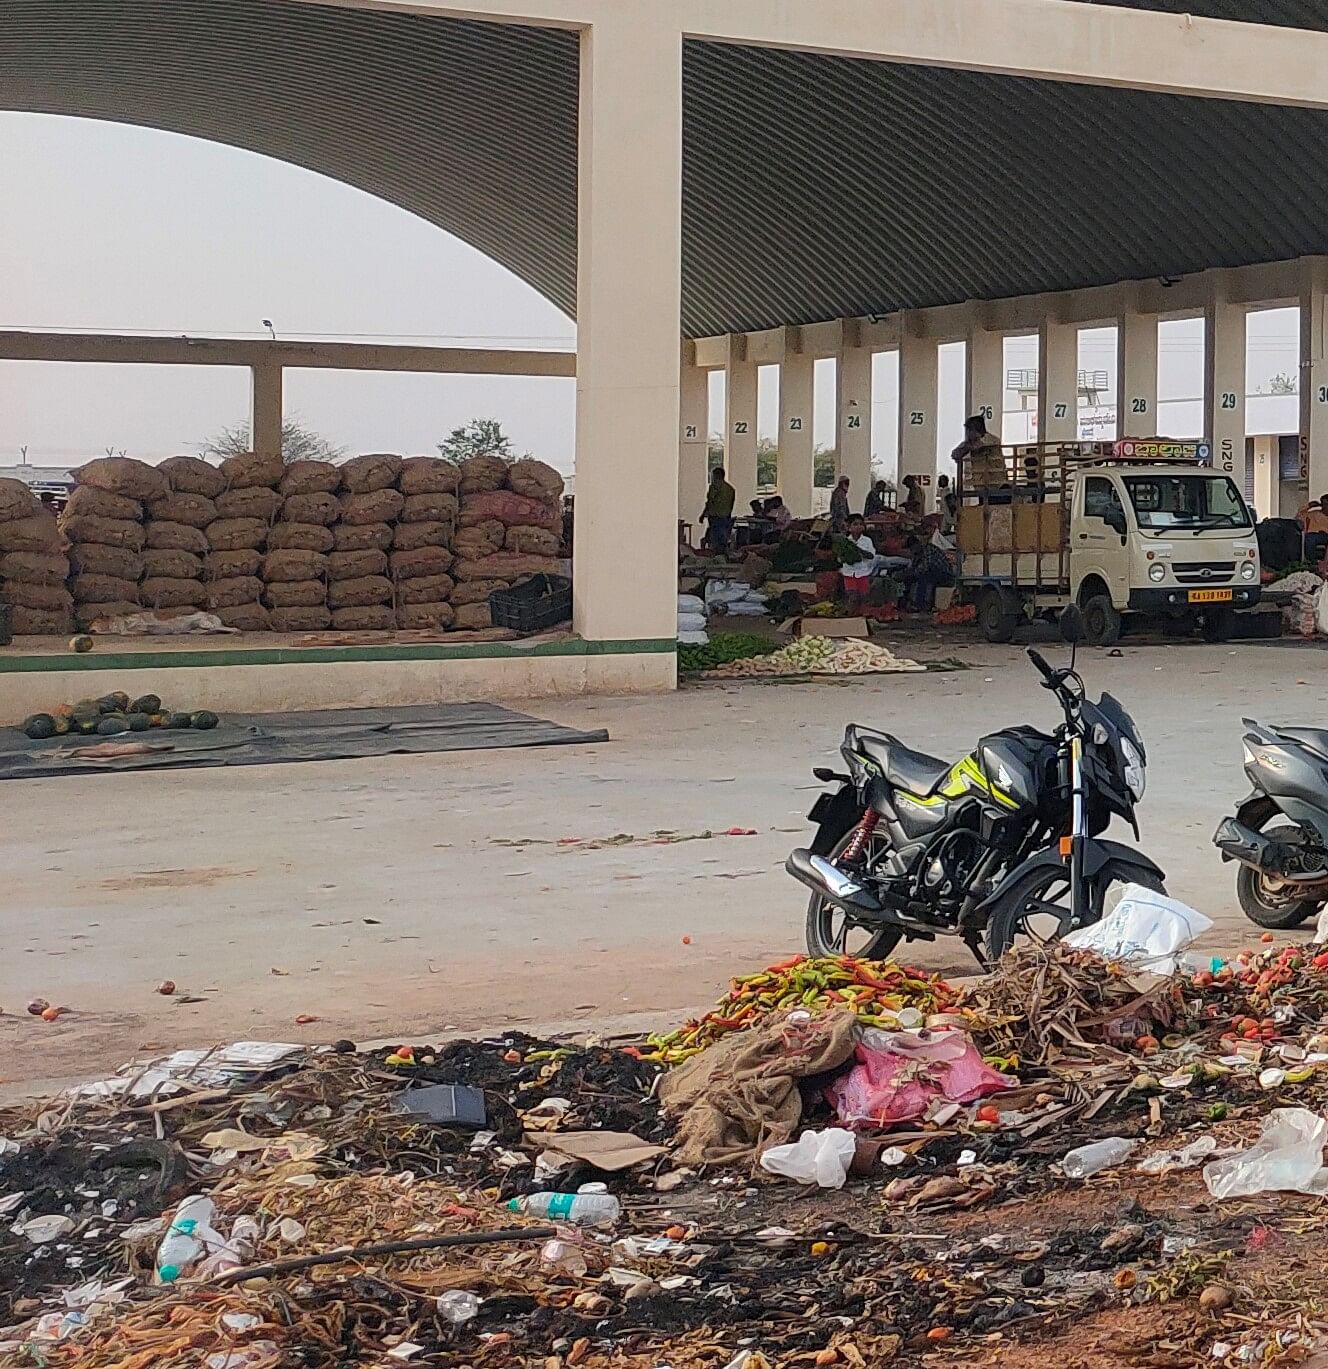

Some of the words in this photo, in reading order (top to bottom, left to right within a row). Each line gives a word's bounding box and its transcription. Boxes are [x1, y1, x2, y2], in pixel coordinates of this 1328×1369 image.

[1132, 399, 1147, 413] 28
[1222, 393, 1236, 408] 29
[980, 406, 992, 419] 26
[1055, 404, 1066, 417] 27
[790, 418, 801, 430] 23
[848, 416, 860, 428] 24
[911, 412, 924, 425] 25
[686, 425, 696, 437] 21
[735, 421, 747, 433] 22
[1221, 439, 1233, 472] SNG
